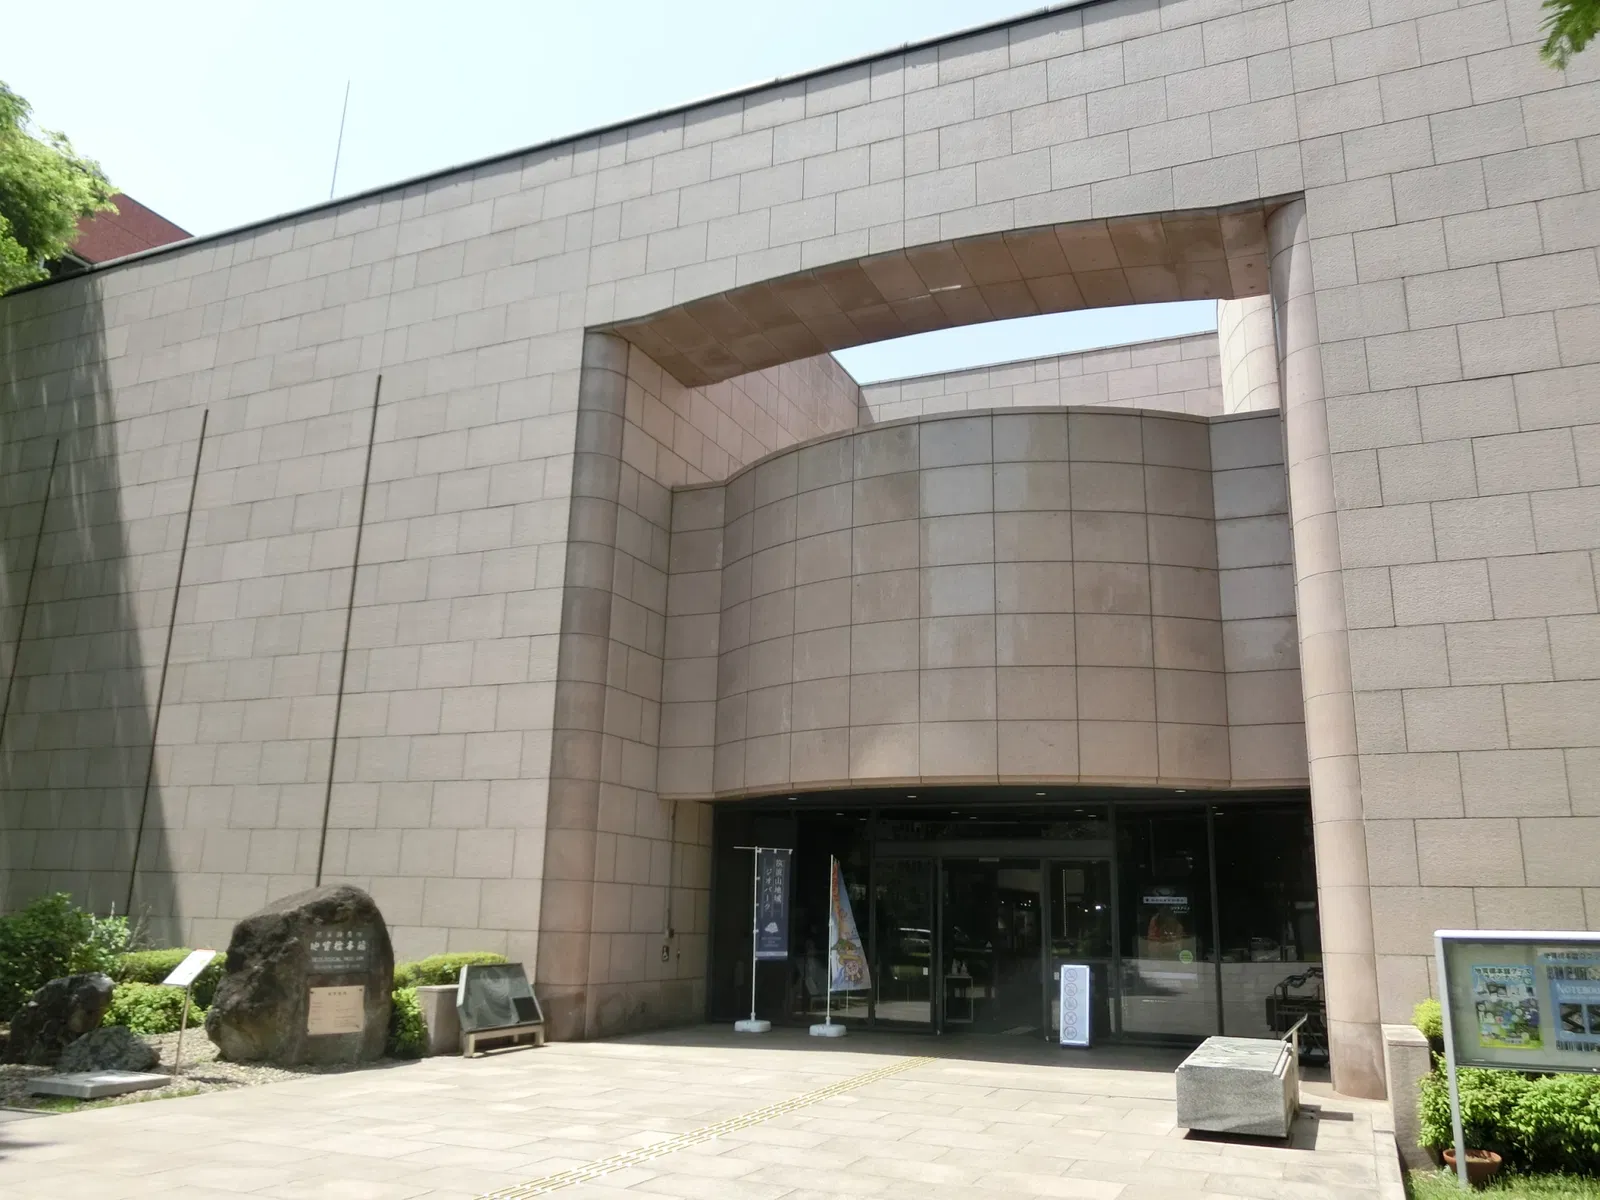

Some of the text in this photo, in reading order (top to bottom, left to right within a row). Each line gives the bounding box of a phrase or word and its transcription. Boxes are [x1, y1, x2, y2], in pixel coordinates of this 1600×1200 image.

[764, 867, 772, 910] ジオパーク
